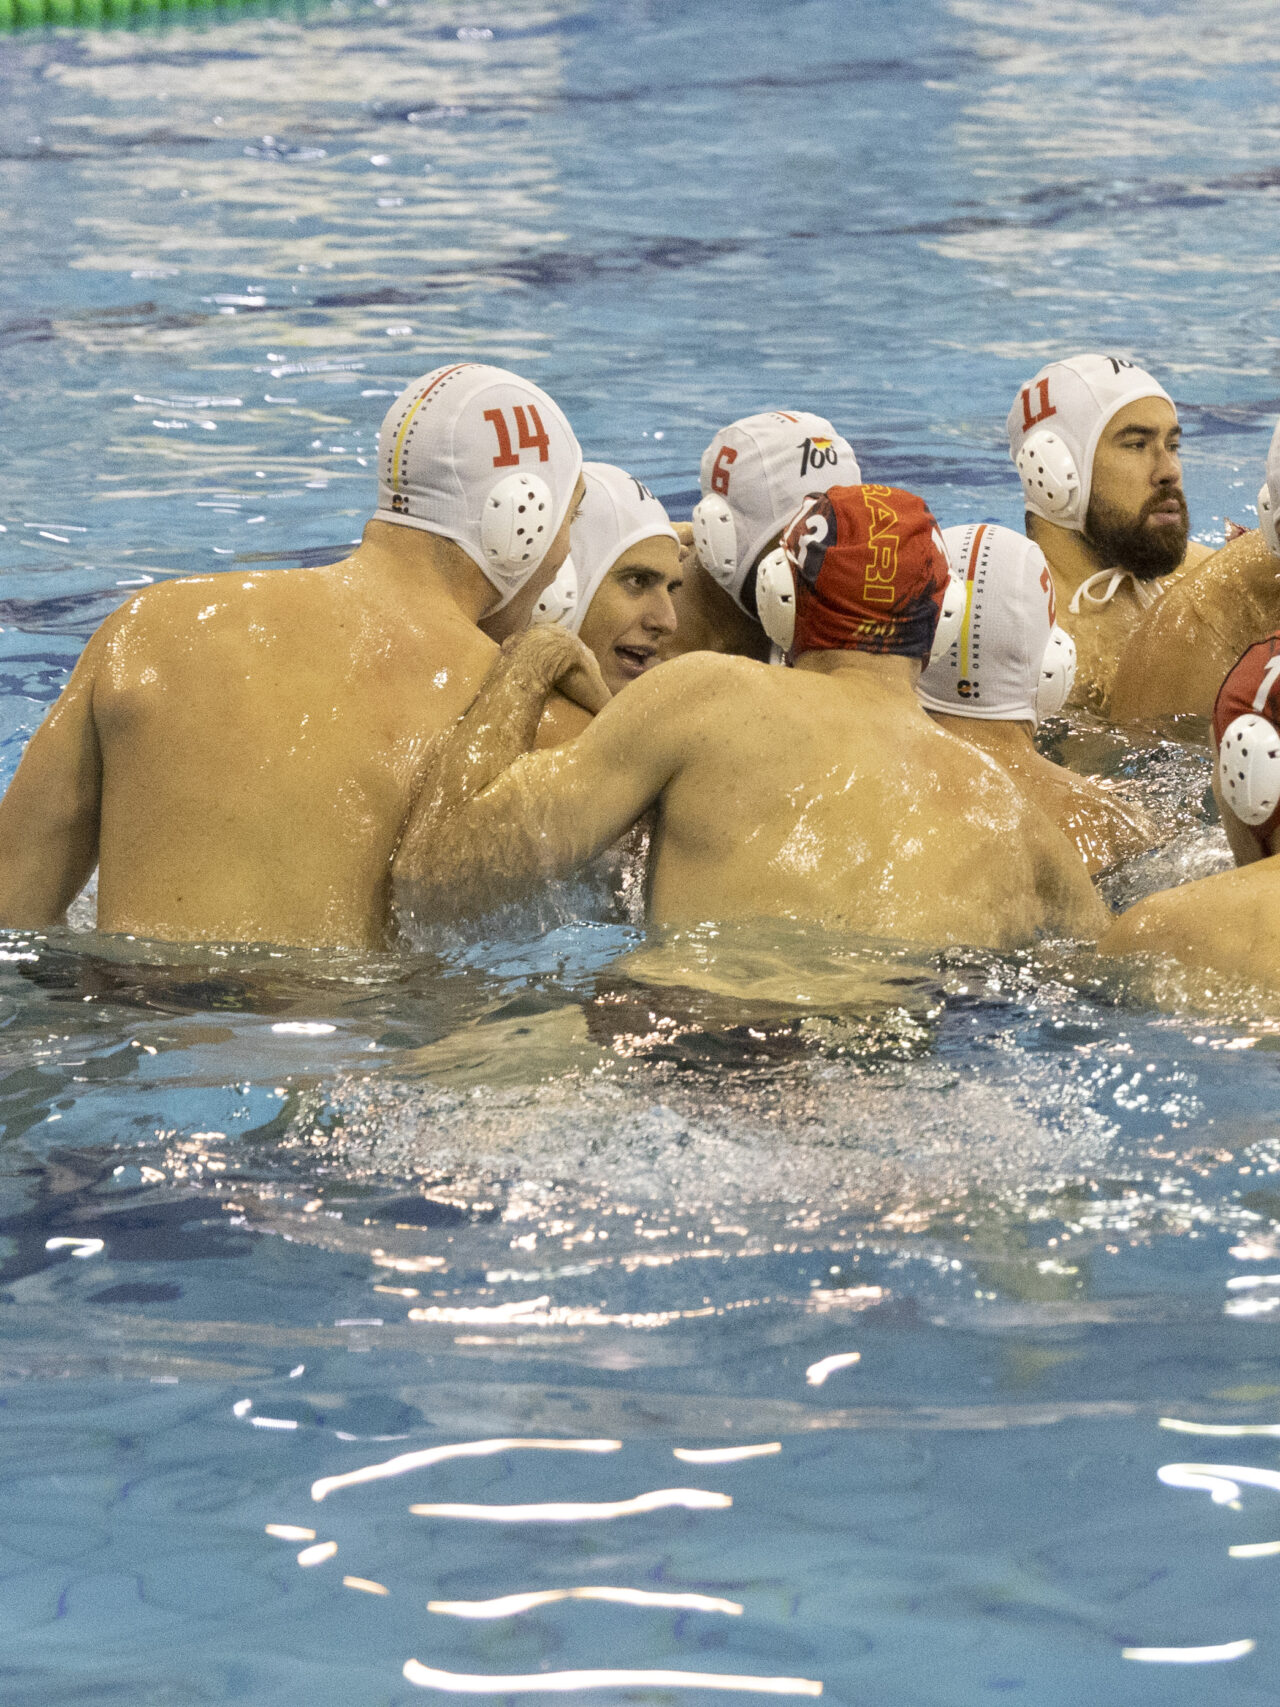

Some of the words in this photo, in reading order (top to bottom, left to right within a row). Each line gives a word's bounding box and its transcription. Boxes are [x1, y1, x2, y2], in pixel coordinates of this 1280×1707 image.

[1020, 377, 1057, 433] 11
[483, 404, 550, 468] 14
[797, 437, 838, 478] 100
[711, 445, 738, 496] 6
[976, 545, 991, 594] NANTES
[971, 603, 982, 670] SALERNO
